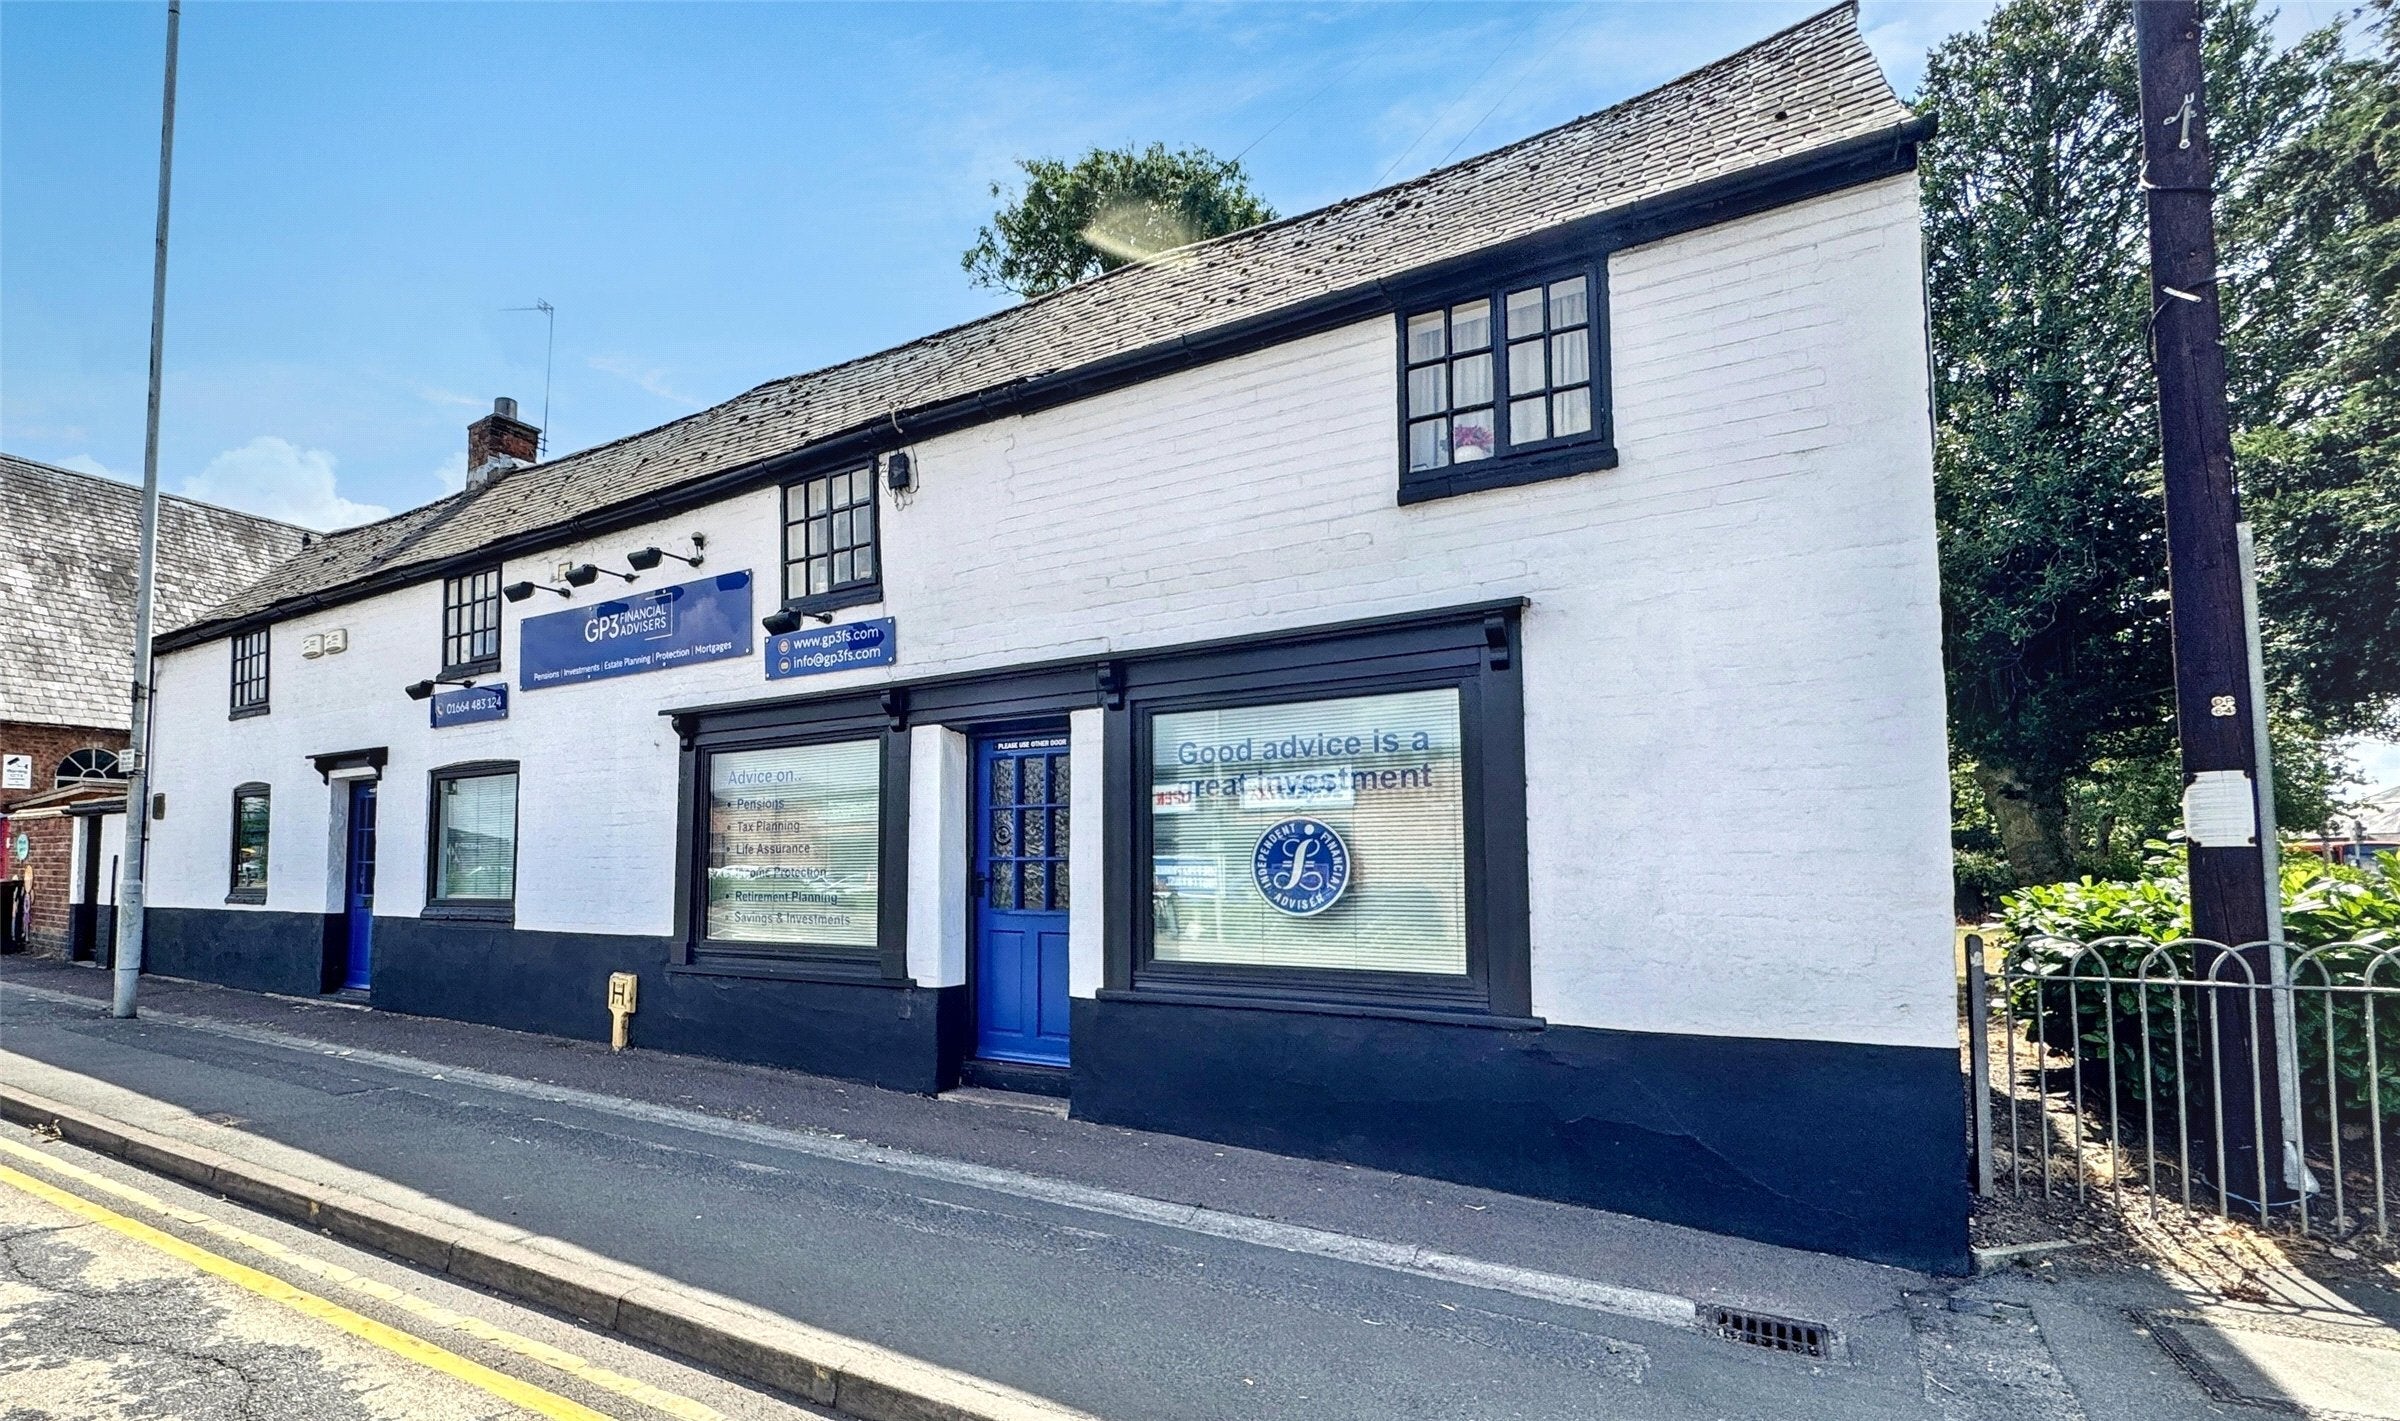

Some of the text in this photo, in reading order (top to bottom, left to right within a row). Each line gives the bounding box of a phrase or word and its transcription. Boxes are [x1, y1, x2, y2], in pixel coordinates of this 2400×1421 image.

[620, 604, 667, 625] FINANCIAL
[584, 614, 619, 642] GP3
[620, 616, 667, 636] ADVISERS
[793, 627, 879, 649] www.gp3fs.com
[533, 641, 732, 681] Pensions Investments Estate Planning Protection Mortgages
[793, 647, 881, 669] info@gp3fs.com
[446, 695, 502, 714] 01664 483 124
[997, 742, 1018, 750] PLEASE
[1178, 728, 1430, 765] Good advice is a
[728, 769, 773, 786] Advice
[1257, 761, 1433, 796] investment
[737, 798, 785, 810] Pensions
[737, 820, 800, 833] Tax Planning
[736, 843, 811, 854] Life Assurance
[1257, 823, 1296, 889] INDEPENDENT
[1320, 831, 1344, 891] FINANCIAL
[773, 866, 827, 879] Protection
[735, 890, 838, 905] Retirement Planning
[1273, 891, 1325, 910] ADVISER
[734, 912, 850, 926] Savings & Investments
[612, 981, 625, 1006] H
